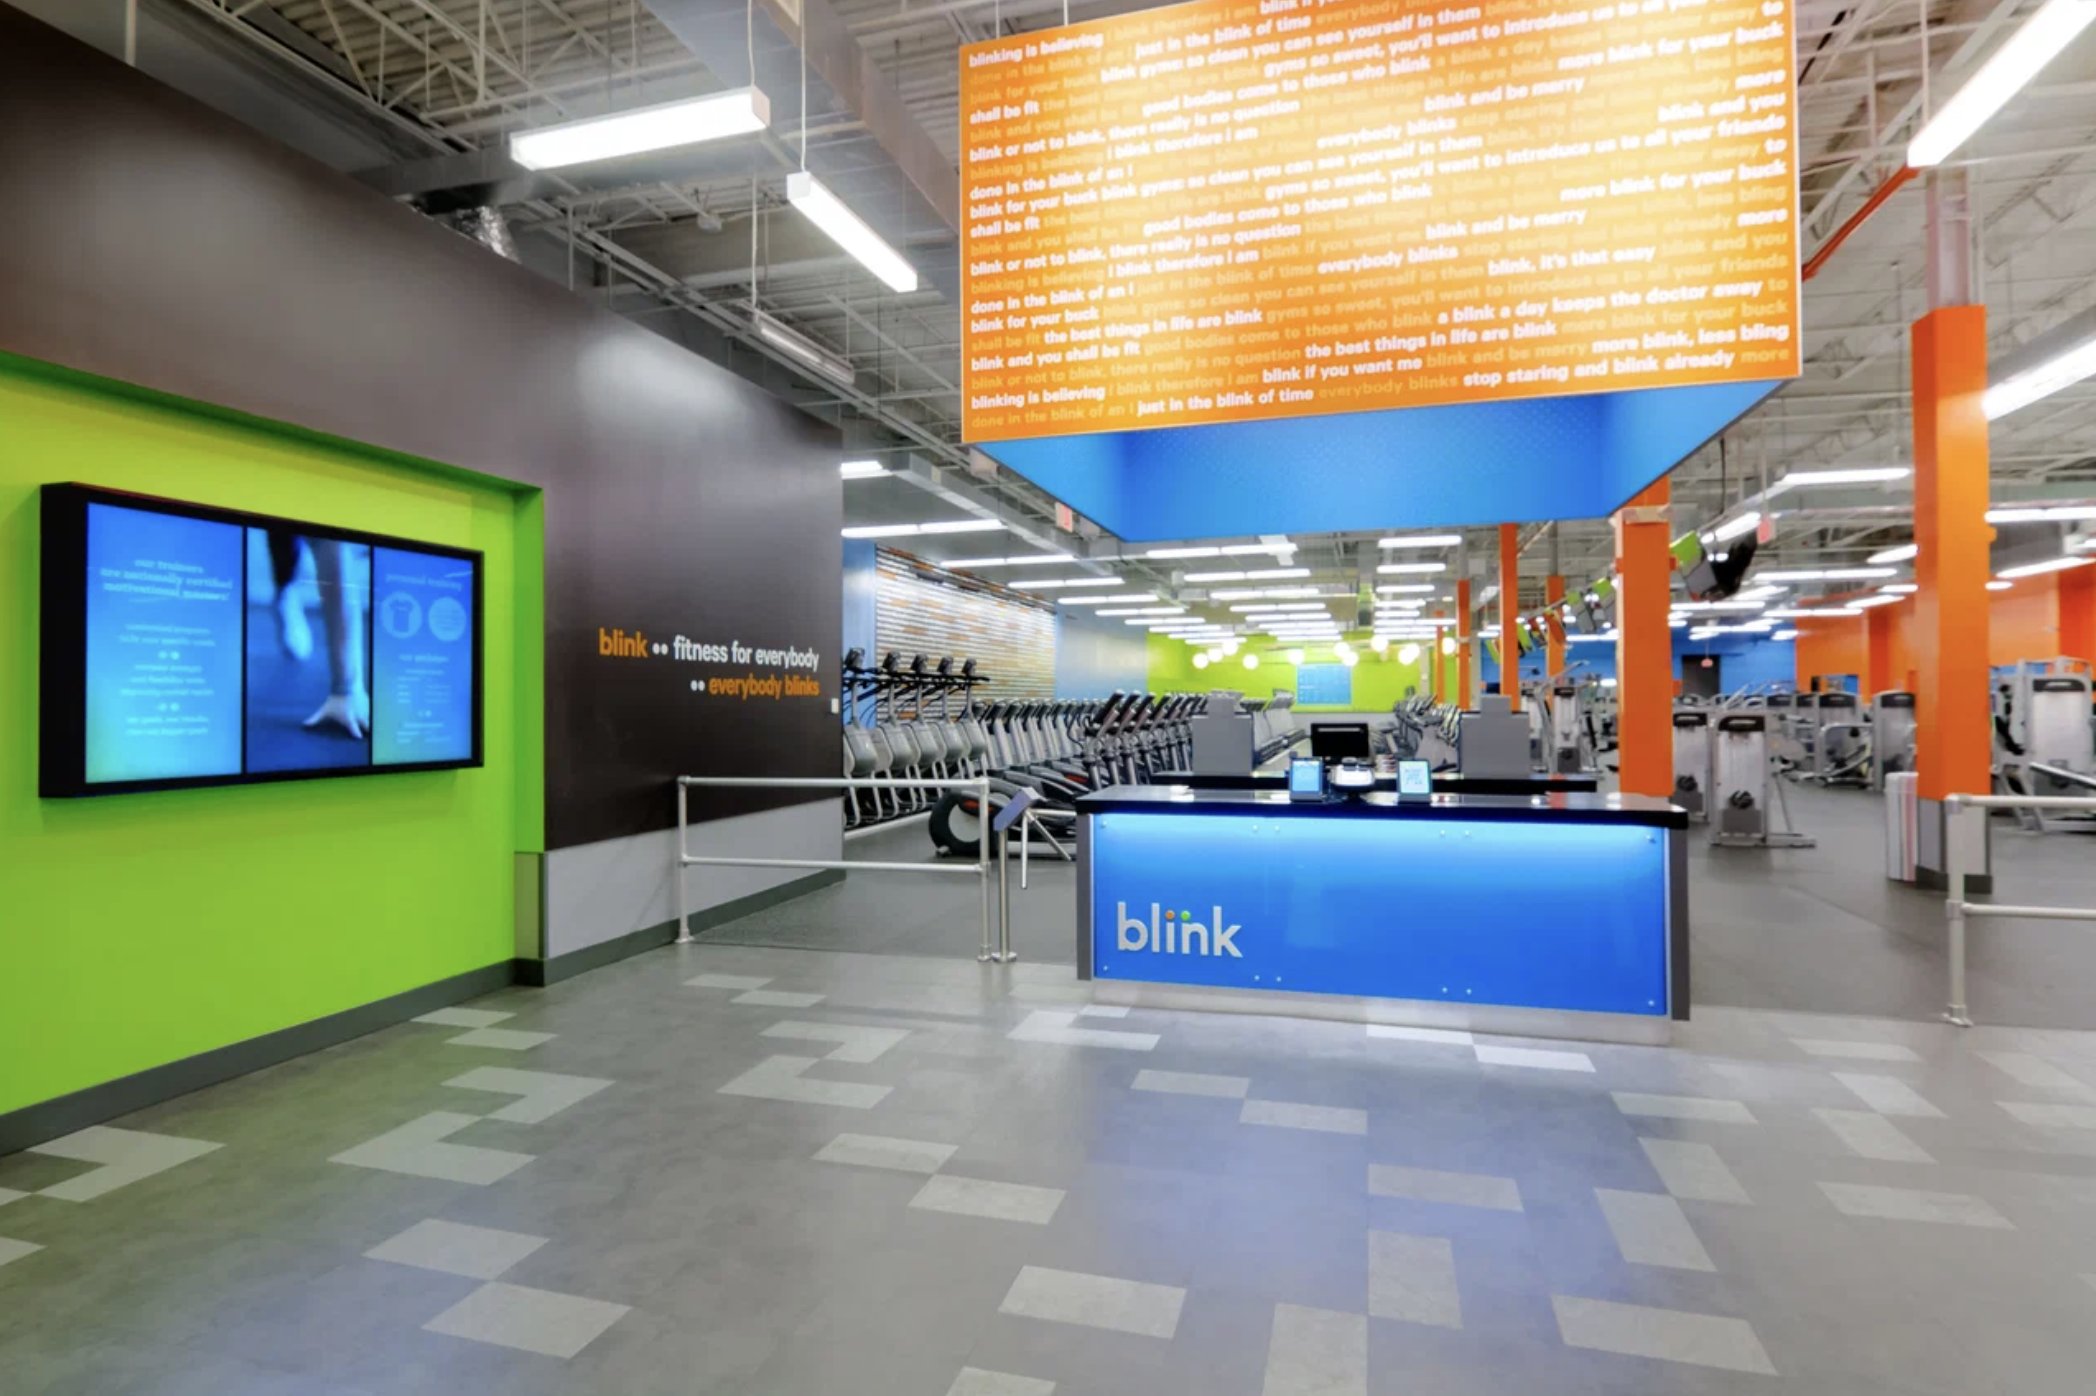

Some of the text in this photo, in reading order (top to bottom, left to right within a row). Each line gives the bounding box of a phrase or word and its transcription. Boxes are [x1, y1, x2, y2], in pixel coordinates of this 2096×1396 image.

[599, 627, 819, 672] blink fitness for everybody
[709, 673, 820, 699] everybody blinks
[1117, 902, 1242, 958] blink
